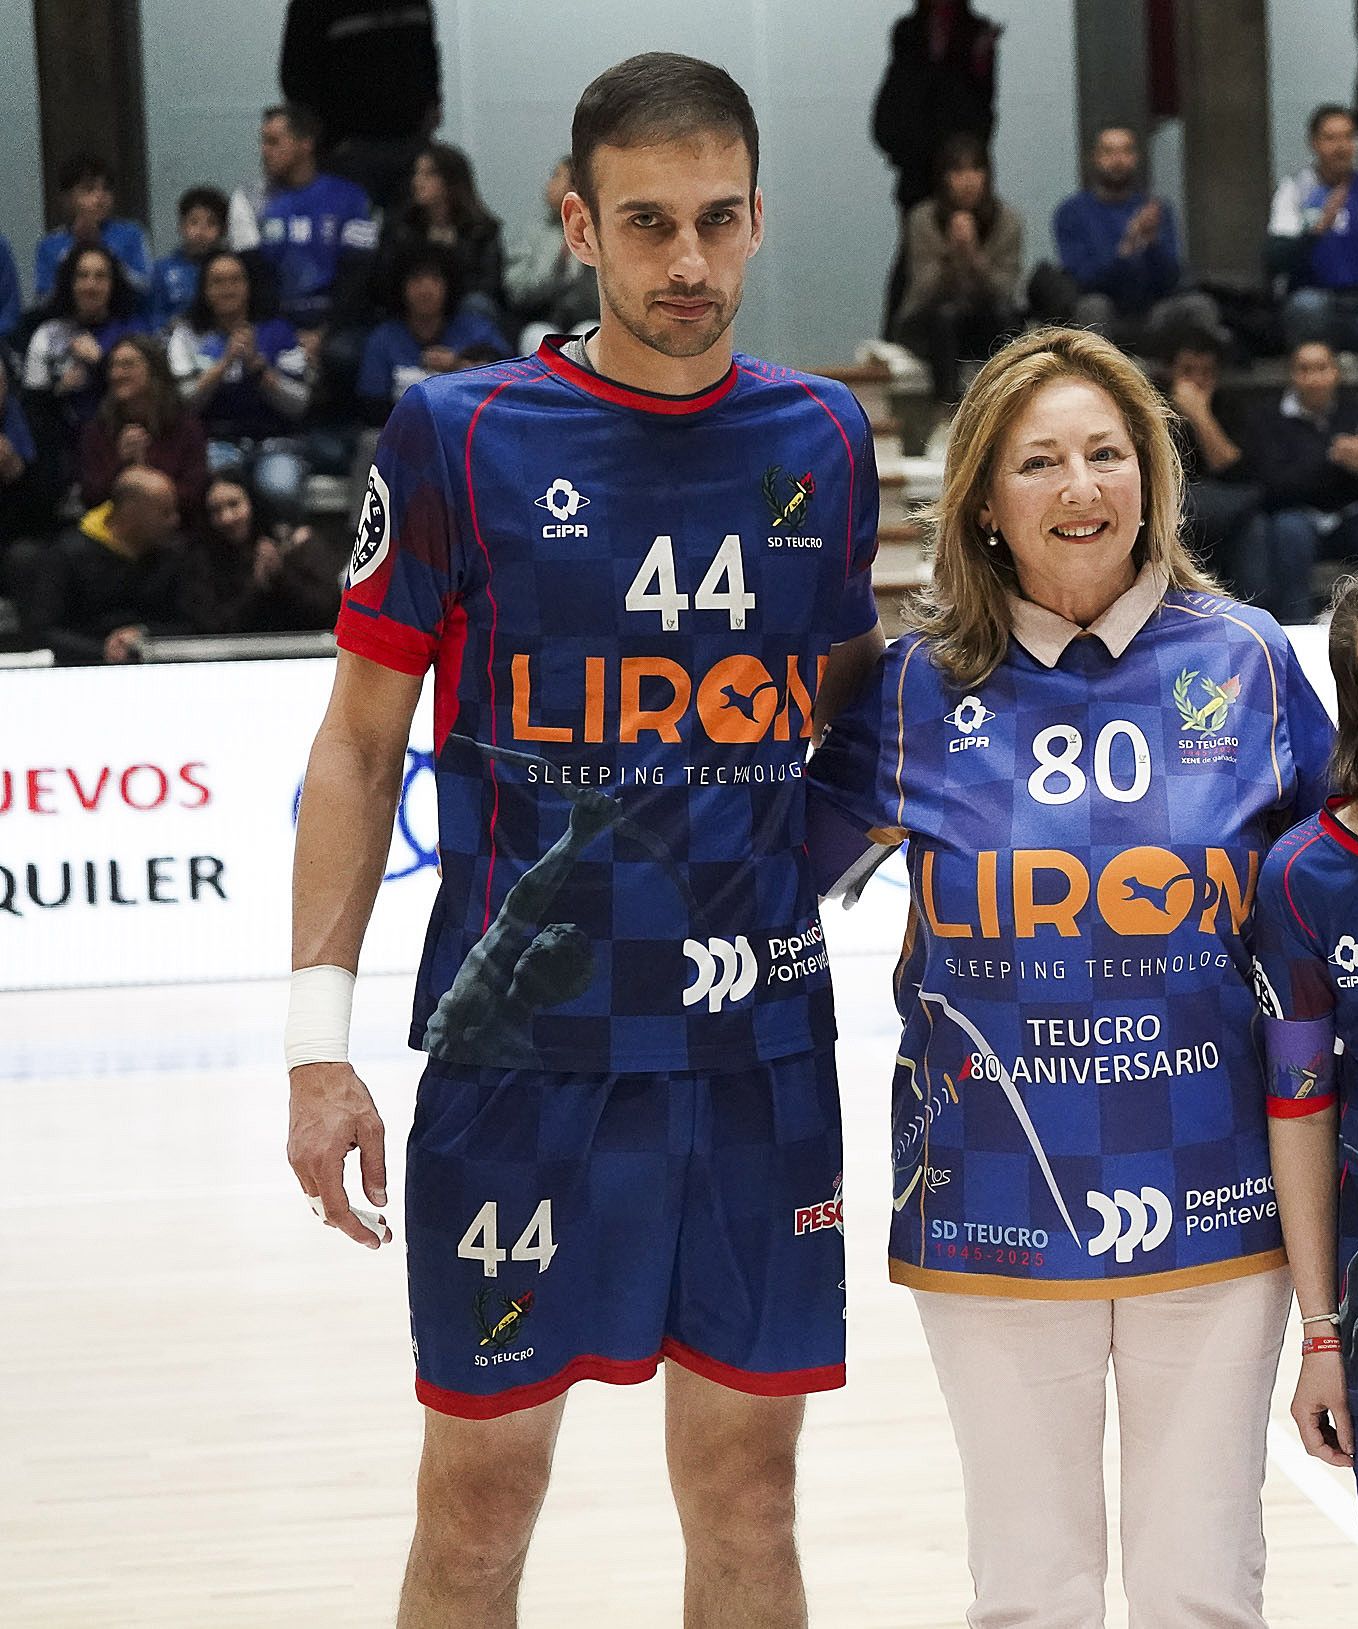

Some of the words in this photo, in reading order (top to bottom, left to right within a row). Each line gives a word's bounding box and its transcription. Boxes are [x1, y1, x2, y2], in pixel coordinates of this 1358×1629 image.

[768, 537, 782, 548] SD
[784, 537, 823, 549] TEUCRO
[624, 535, 756, 631] 44
[512, 653, 829, 744] LIRON
[1178, 739, 1194, 749] SD
[1195, 736, 1240, 750] TEUCRO
[528, 764, 664, 785] SLEEPING
[1028, 718, 1152, 803] 80
[1181, 757, 1201, 765] XENE
[922, 846, 1258, 938] LIRON
[945, 958, 1066, 979] SLEEPING
[1085, 951, 1237, 977] TECHNOLOG
[1027, 1014, 1162, 1047] TEUCRO
[970, 1051, 1001, 1083] 80
[1010, 1041, 1220, 1085] ANIVERSARIO
[457, 1199, 559, 1278] 44
[932, 1219, 958, 1240] SD
[963, 1222, 1049, 1249] TEUCRO
[935, 1243, 1045, 1267] 1945-2025
[474, 1354, 489, 1367] SD
[491, 1347, 534, 1364] TEUCRO
